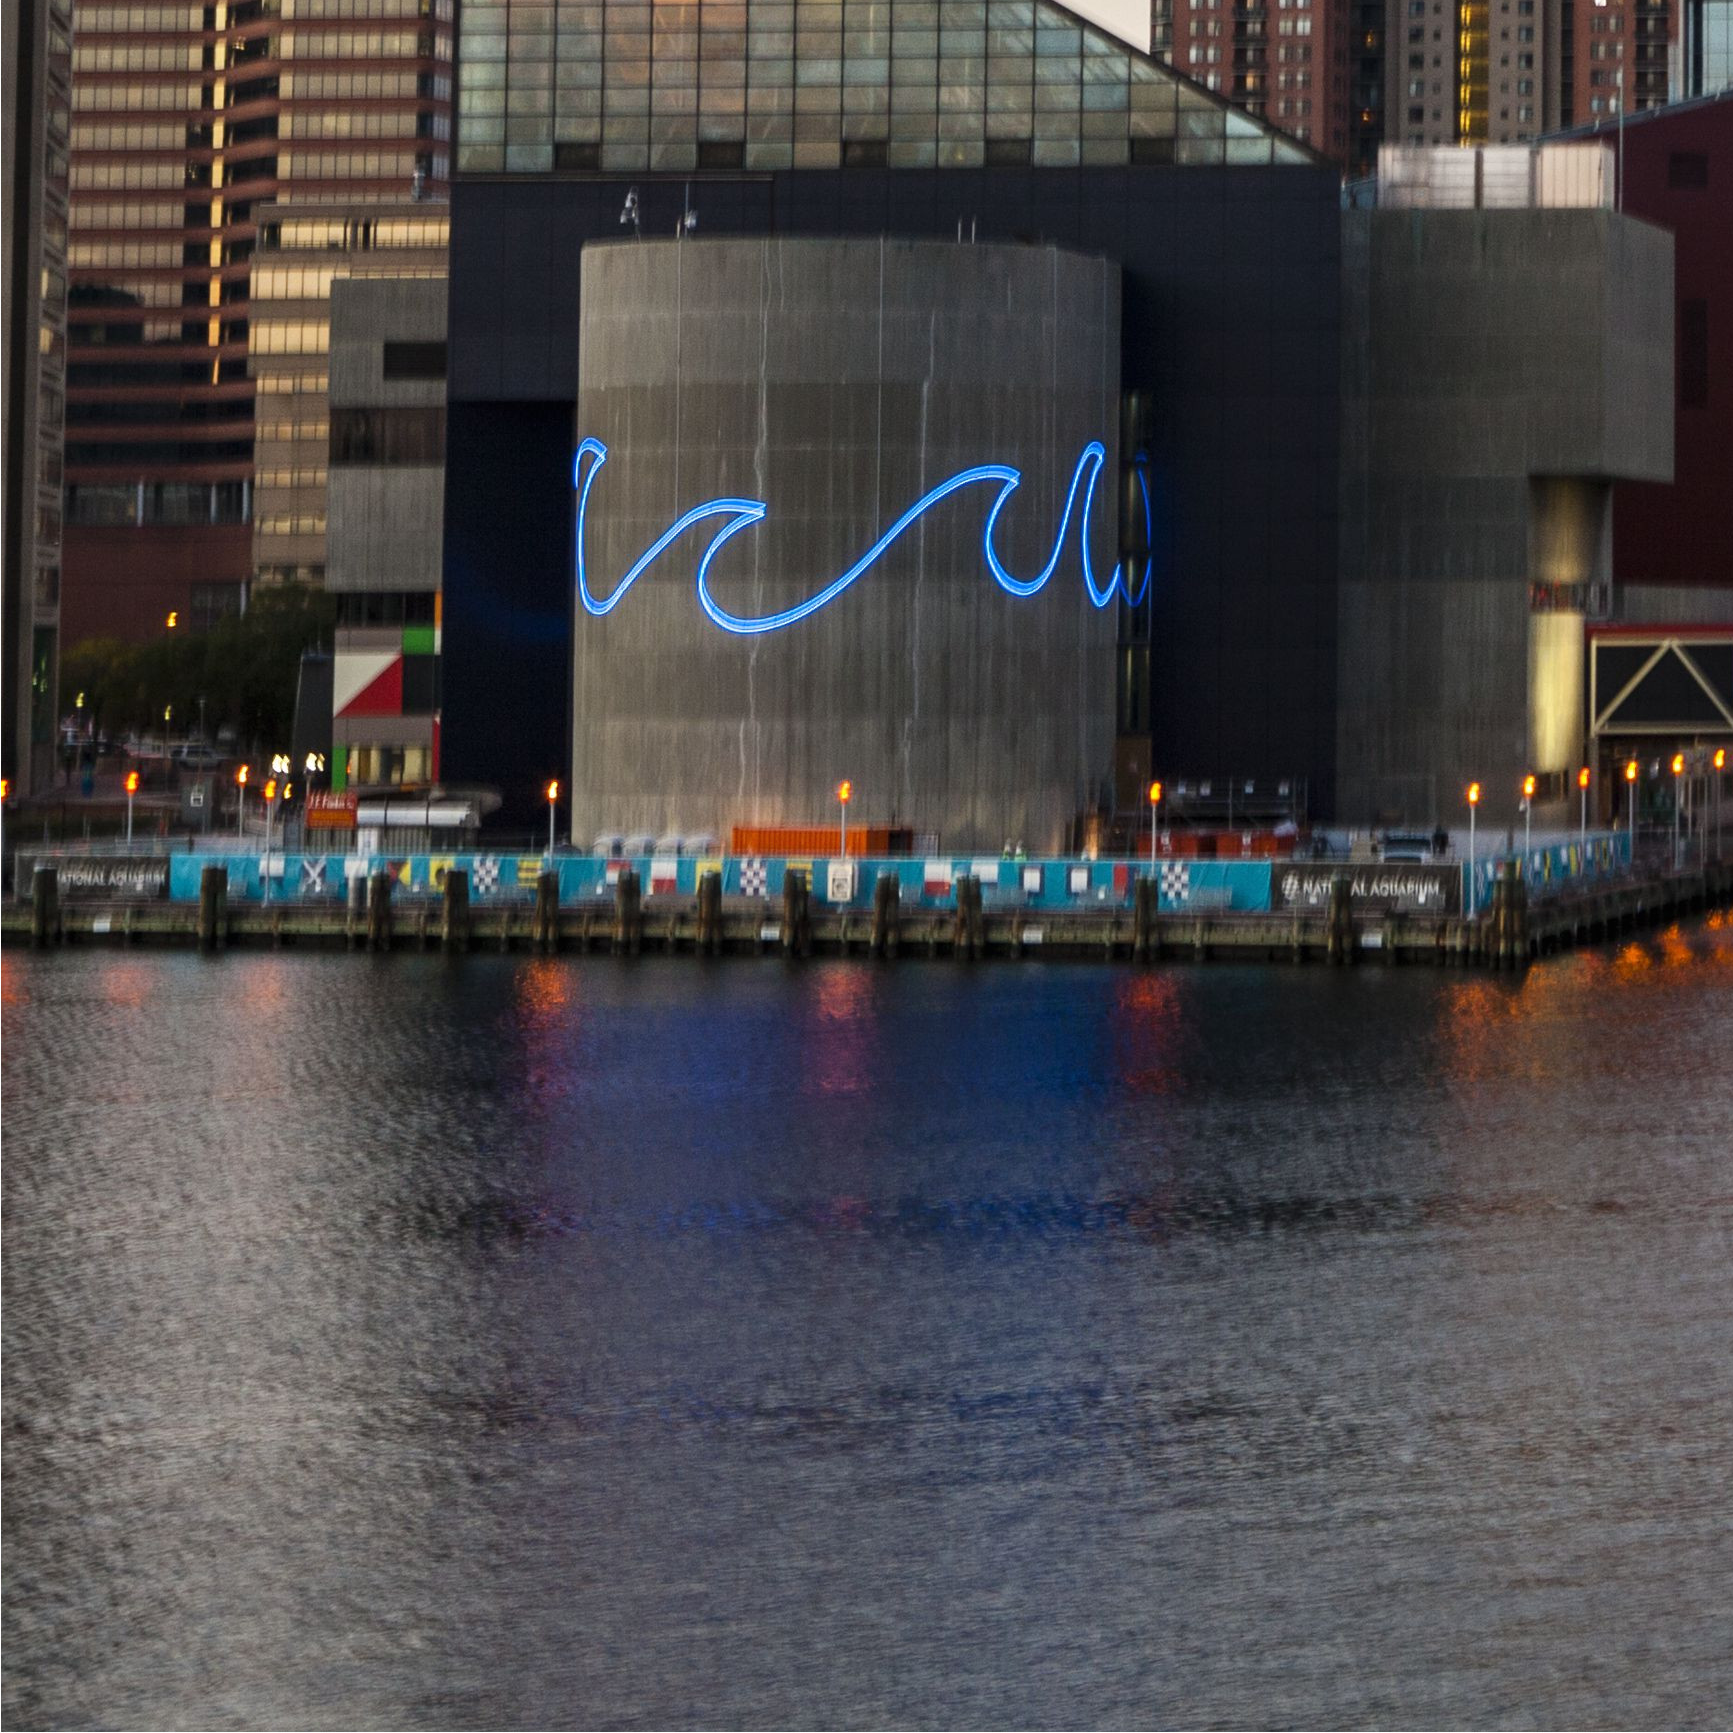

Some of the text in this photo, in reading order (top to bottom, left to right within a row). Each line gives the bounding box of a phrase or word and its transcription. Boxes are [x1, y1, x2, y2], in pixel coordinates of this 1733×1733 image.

[108, 872, 166, 886] AQUARIUM
[1302, 876, 1440, 897] NATIAL AQUARIUM
